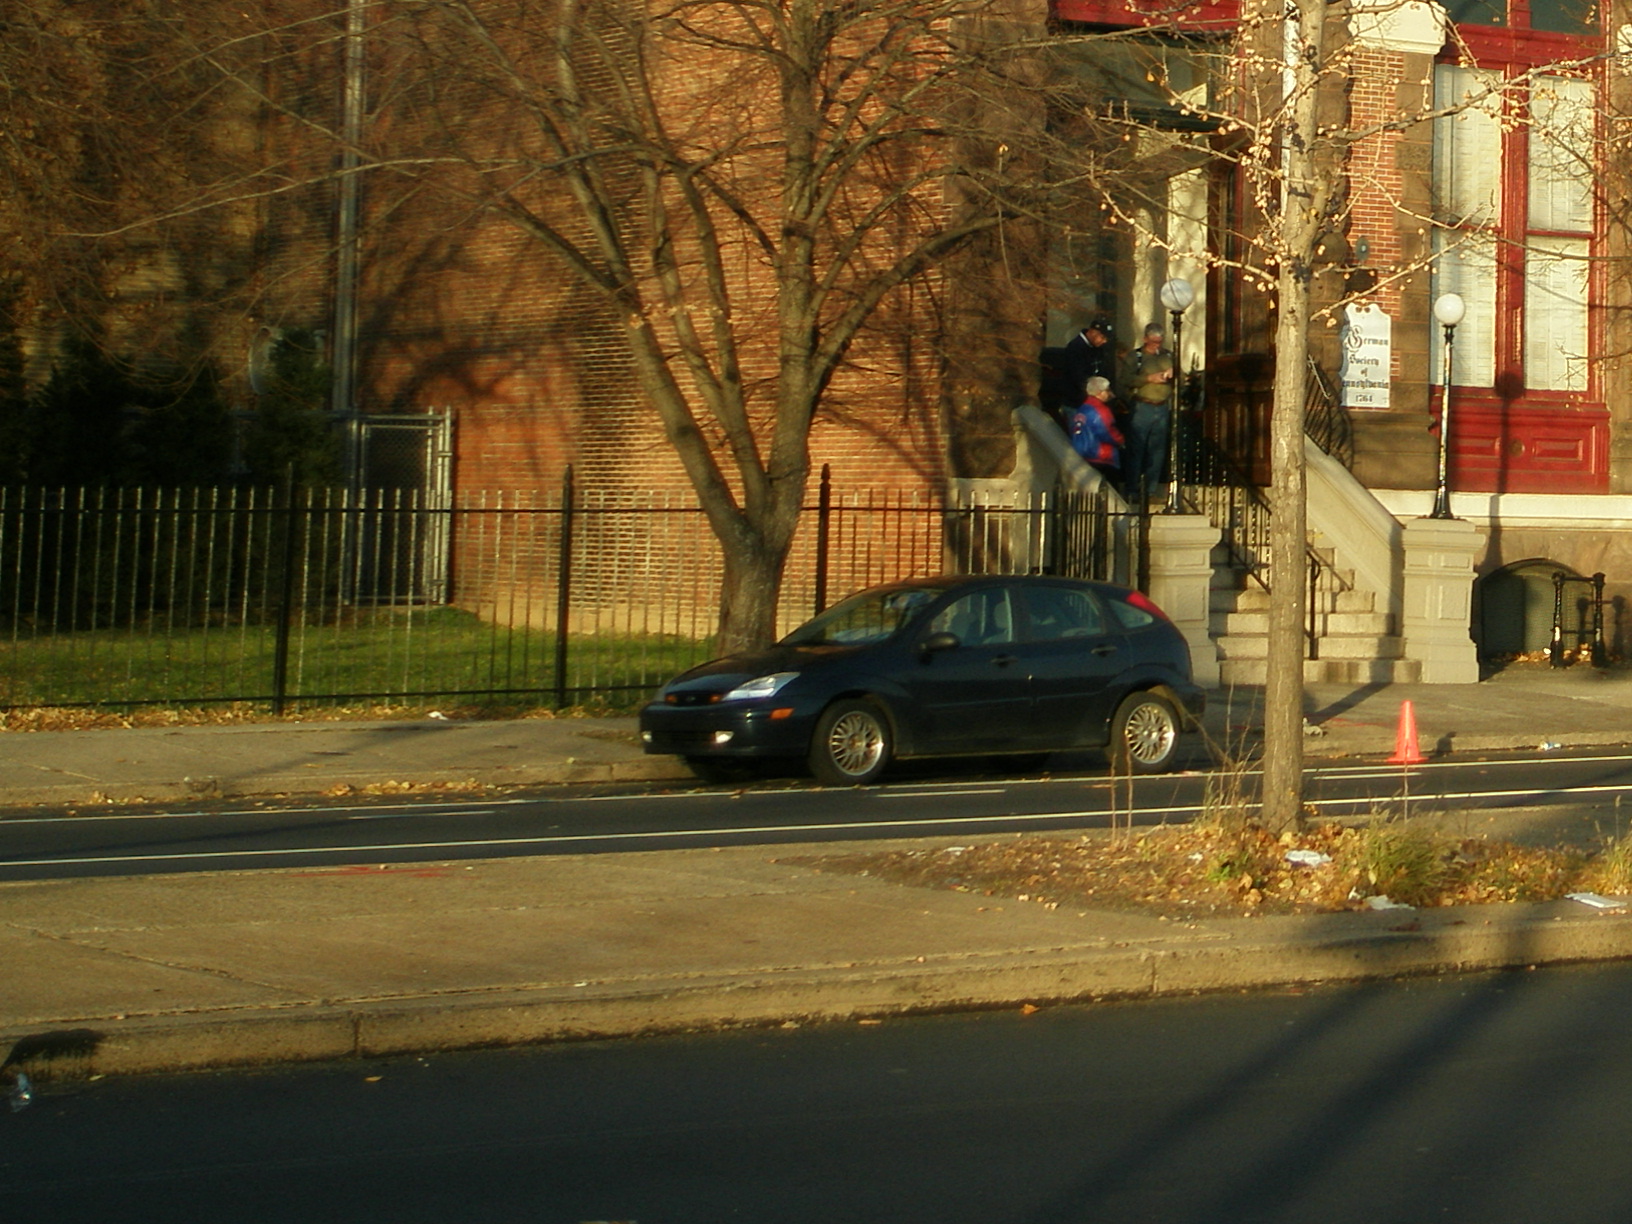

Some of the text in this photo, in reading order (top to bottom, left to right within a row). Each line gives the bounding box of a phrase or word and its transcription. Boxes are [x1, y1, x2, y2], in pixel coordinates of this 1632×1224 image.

[1349, 354, 1380, 366] Society
[1360, 367, 1368, 377] of
[1342, 378, 1389, 389] ennsylvania
